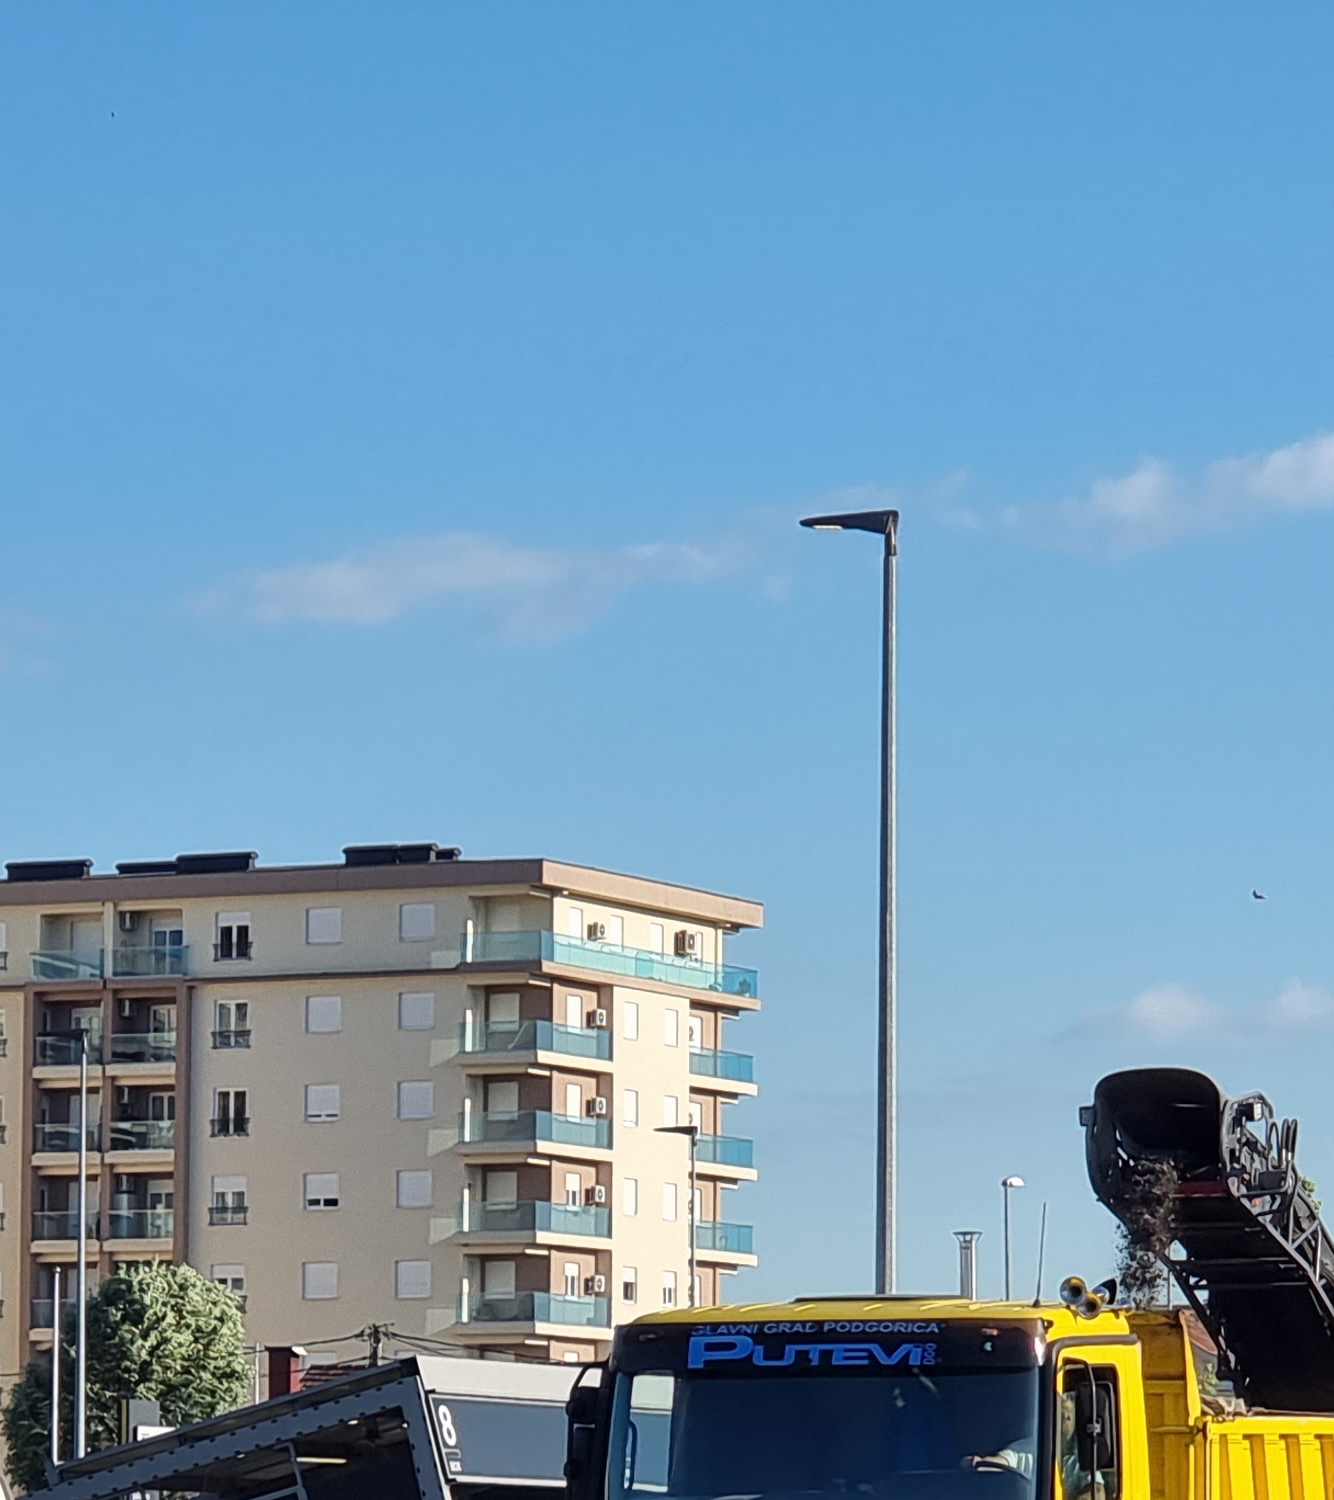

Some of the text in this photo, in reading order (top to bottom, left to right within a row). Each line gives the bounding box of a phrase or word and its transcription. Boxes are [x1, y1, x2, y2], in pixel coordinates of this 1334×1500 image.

[764, 1322, 817, 1334] GRAD
[823, 1321, 940, 1333] PODGORICA
[438, 1404, 457, 1446] 8
